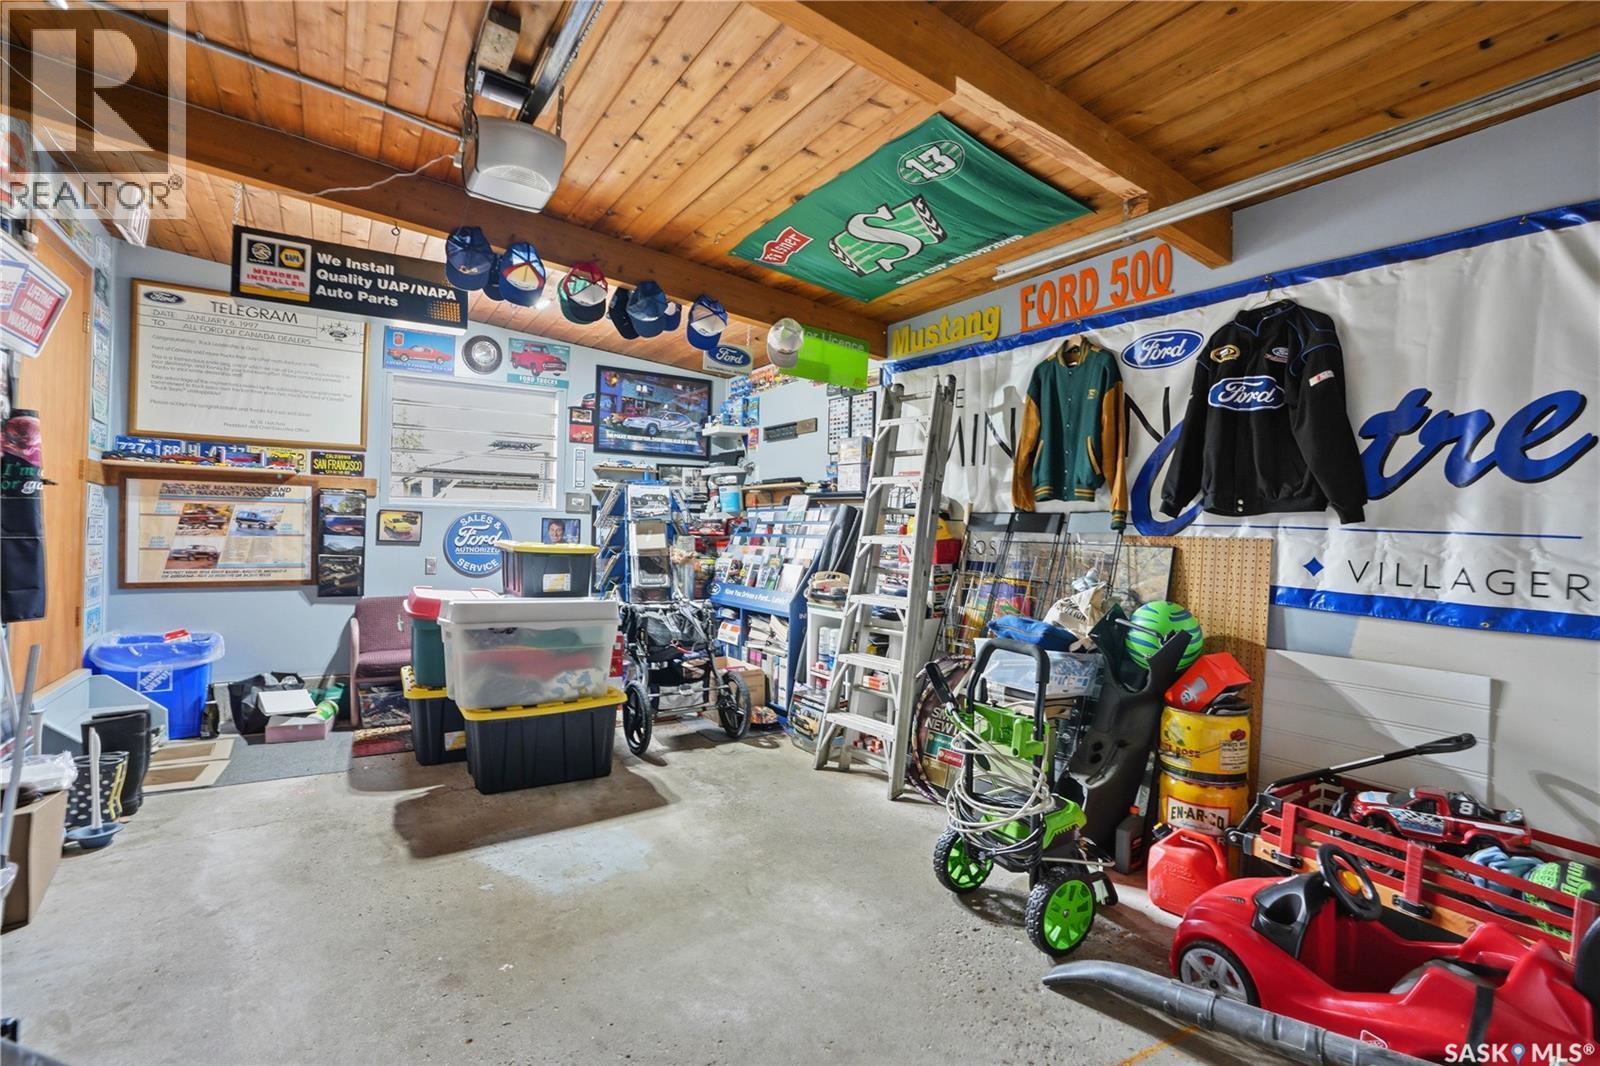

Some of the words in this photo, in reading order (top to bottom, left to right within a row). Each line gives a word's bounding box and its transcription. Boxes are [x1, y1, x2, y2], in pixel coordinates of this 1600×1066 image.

[905, 144, 957, 180] 13
[847, 203, 924, 272] S
[252, 267, 300, 280] MEMBER
[316, 252, 341, 267] We
[346, 258, 395, 276] Install
[246, 273, 305, 287] INSTALLER
[316, 269, 373, 290] Quality
[377, 278, 457, 301] UAP/NAPA
[1019, 267, 1099, 332] FORD
[1109, 242, 1173, 307] 500
[316, 285, 353, 301] Auto
[358, 290, 399, 307] Parts
[184, 313, 228, 327] JANUARY
[239, 320, 259, 329] 1997
[210, 300, 299, 324] TELEGRAM
[183, 322, 198, 332] ALL
[200, 324, 223, 334] FORD
[224, 327, 237, 336] OF
[238, 329, 276, 341] CANADA
[277, 334, 312, 346] DEALERS
[822, 332, 865, 352] Licence
[891, 304, 1001, 360] Mustang
[715, 347, 744, 364] Ford
[1217, 380, 1275, 404] Ford
[313, 458, 327, 470] SAN
[327, 459, 363, 472] FRANCISCO
[196, 489, 240, 497] WARRANTY
[243, 490, 285, 498] PROGRAM
[272, 486, 292, 494] AND
[460, 514, 494, 526] SALES
[493, 519, 501, 530] &
[454, 525, 502, 546] Ford
[457, 558, 499, 572] SERVICE
[1347, 559, 1594, 602] VILLAGER
[925, 717, 953, 735] NEW
[1458, 801, 1475, 815] 8
